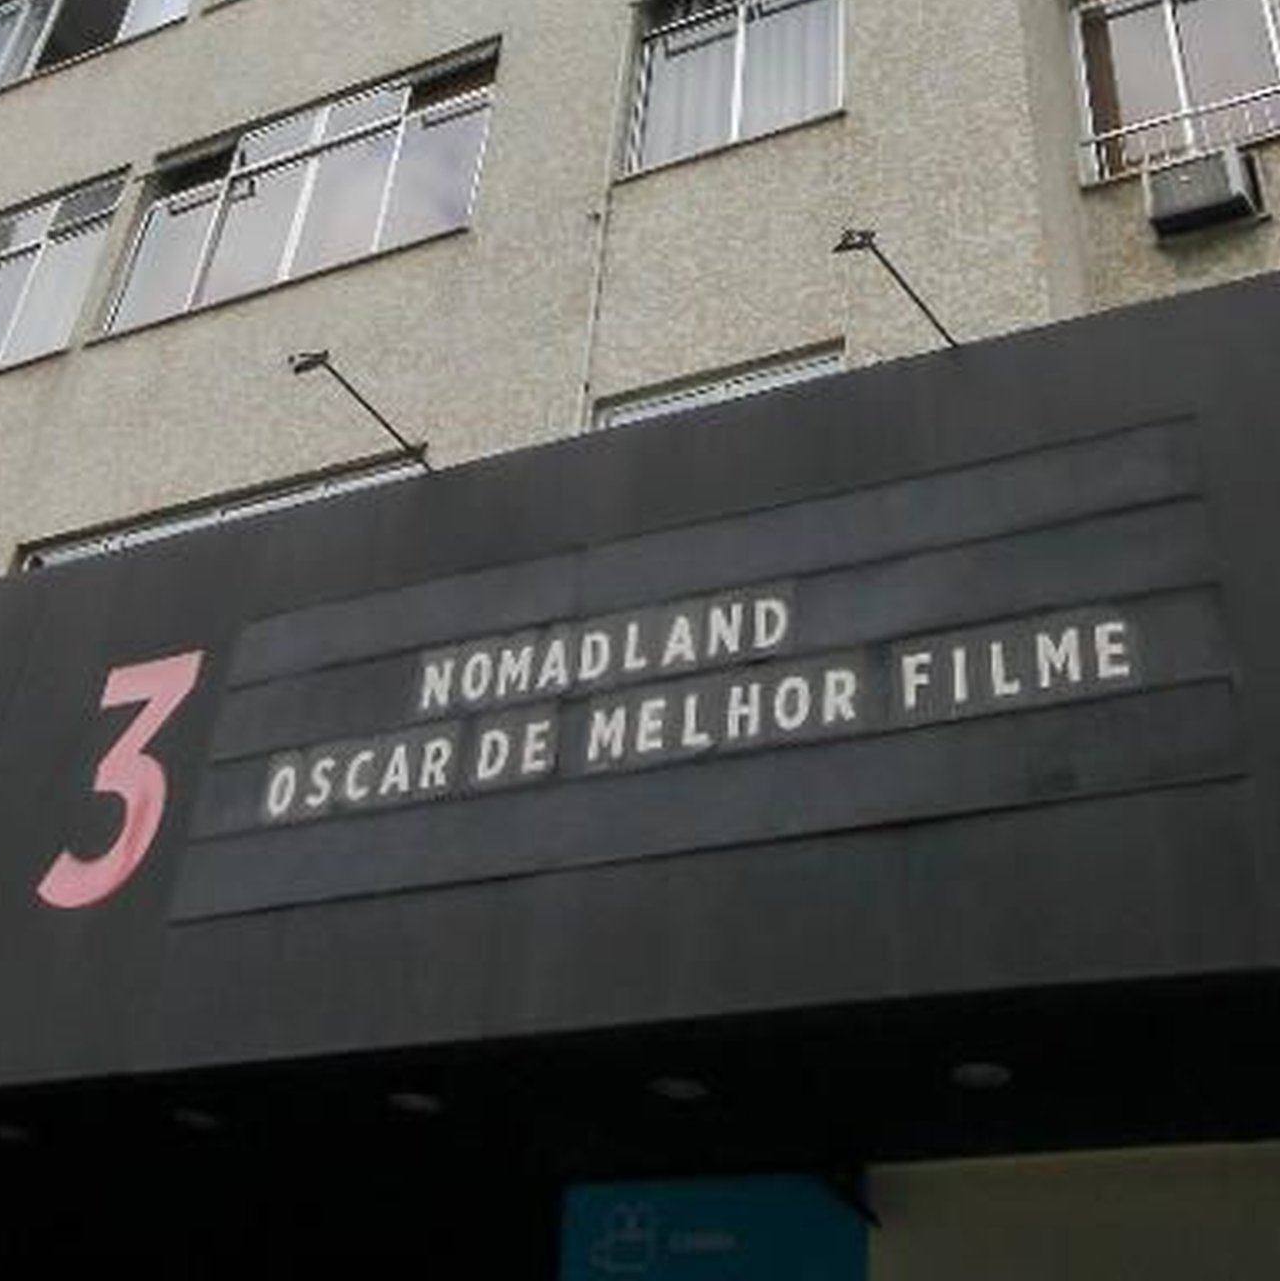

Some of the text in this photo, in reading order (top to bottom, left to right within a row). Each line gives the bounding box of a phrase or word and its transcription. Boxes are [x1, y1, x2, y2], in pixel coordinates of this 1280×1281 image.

[266, 622, 1131, 816] OSCAR DE MELHOR FILME
[420, 598, 788, 709] NOMADLAND
[38, 650, 204, 908] 3
